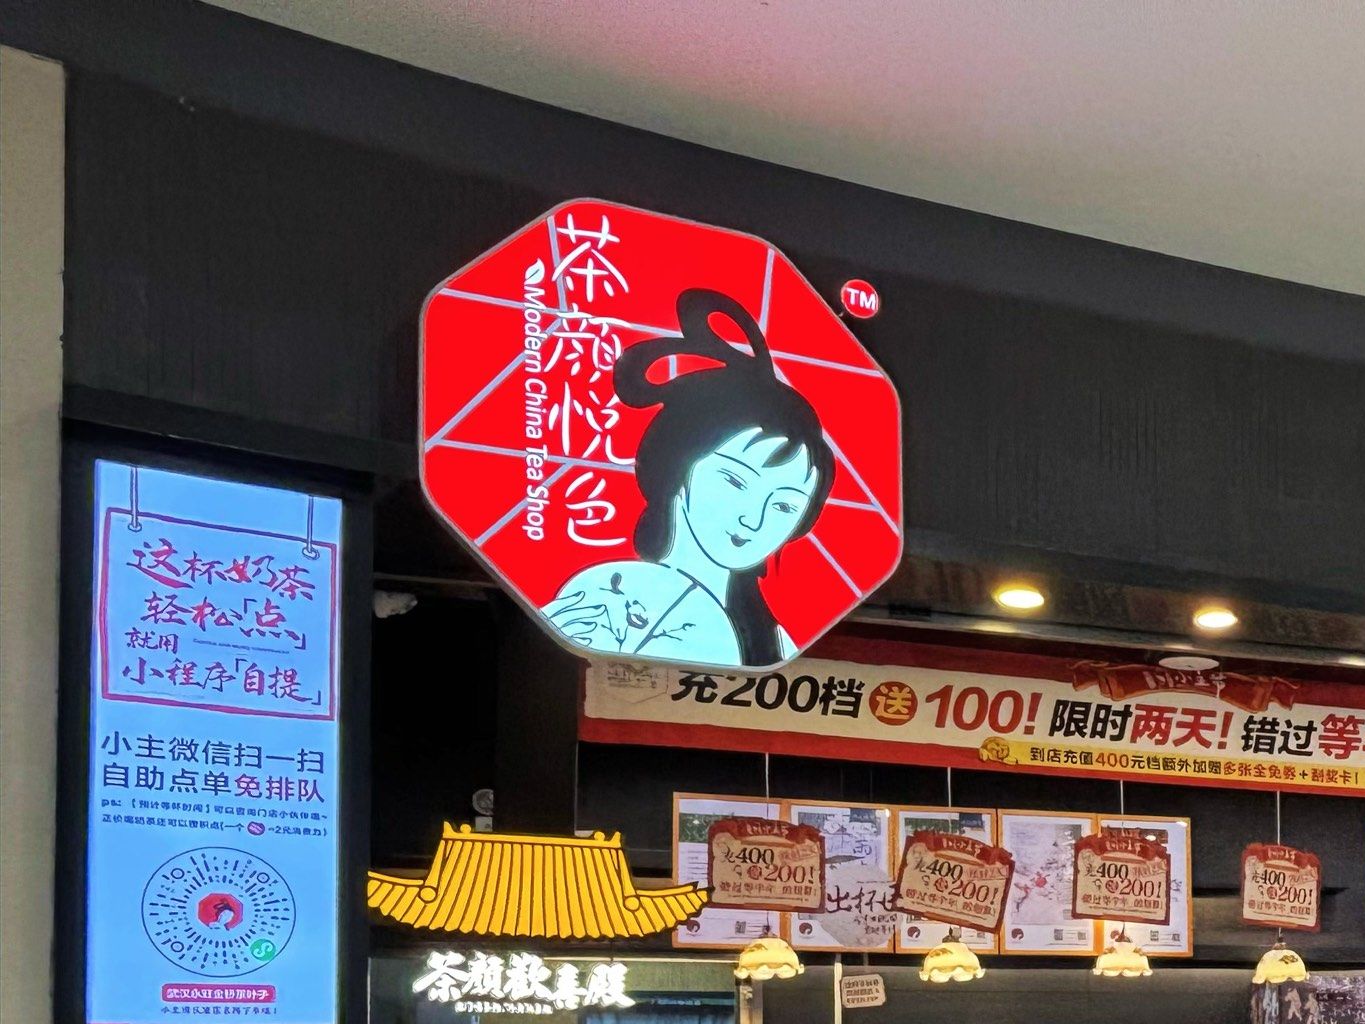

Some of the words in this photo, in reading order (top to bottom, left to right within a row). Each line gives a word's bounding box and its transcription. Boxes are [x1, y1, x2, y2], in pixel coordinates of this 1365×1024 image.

[847, 286, 877, 310] TM
[523, 284, 546, 373] Modern
[543, 212, 636, 548] 茶颜悦色
[524, 374, 548, 439] China
[525, 445, 550, 480] Tea
[526, 484, 551, 541] Shop
[126, 538, 315, 601] 这杯奶茶
[125, 627, 178, 654] 就用
[1049, 699, 1234, 751] 限时两天!
[101, 731, 325, 774] 小主微信扫一扫
[103, 762, 325, 803] 自助点单免排队
